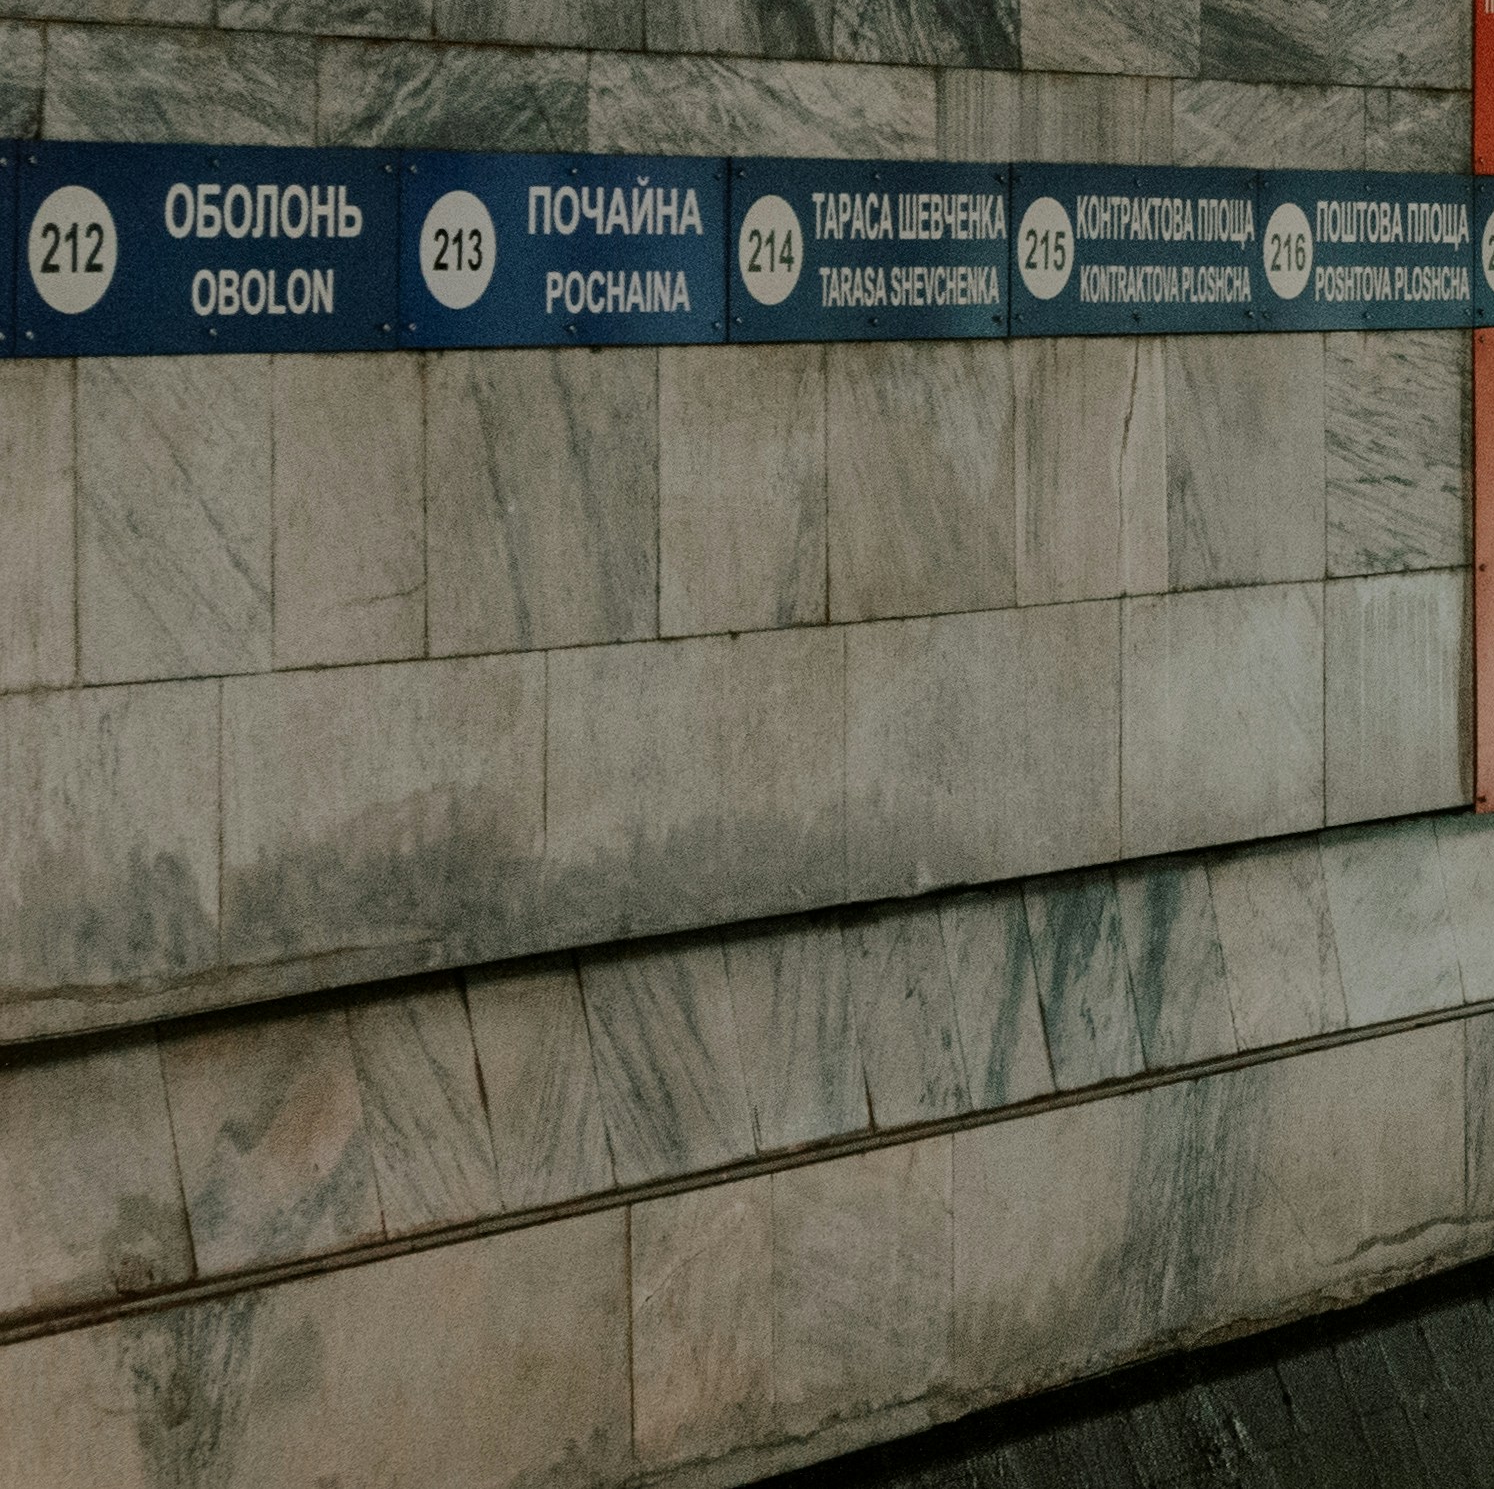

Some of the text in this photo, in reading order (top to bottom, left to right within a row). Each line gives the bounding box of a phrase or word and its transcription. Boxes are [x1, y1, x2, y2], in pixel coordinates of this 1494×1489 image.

[165, 183, 363, 239] ОБОЛОНЬ
[528, 176, 703, 235] ПОЧАЙНА
[812, 192, 1008, 240] ТАРАСА ШЕВЧЕНКА
[1076, 195, 1255, 249] КОНТРАКТОВА ПЛОЩА
[1316, 201, 1470, 251] ПОШТОВА ПЛОЩА
[41, 222, 104, 274] 212
[433, 228, 483, 271] 213
[748, 229, 795, 273] 214
[1025, 229, 1066, 271] 215
[1271, 233, 1306, 272] 216
[191, 269, 334, 315] OBOLON
[547, 270, 690, 313] POCHAINA
[820, 266, 999, 307] TARASA SHEVCHENKA
[1080, 264, 1252, 303] KONTRAKTOVA PLOSHCHA
[1315, 266, 1470, 303] POSHTOVA PLOSHCHA
